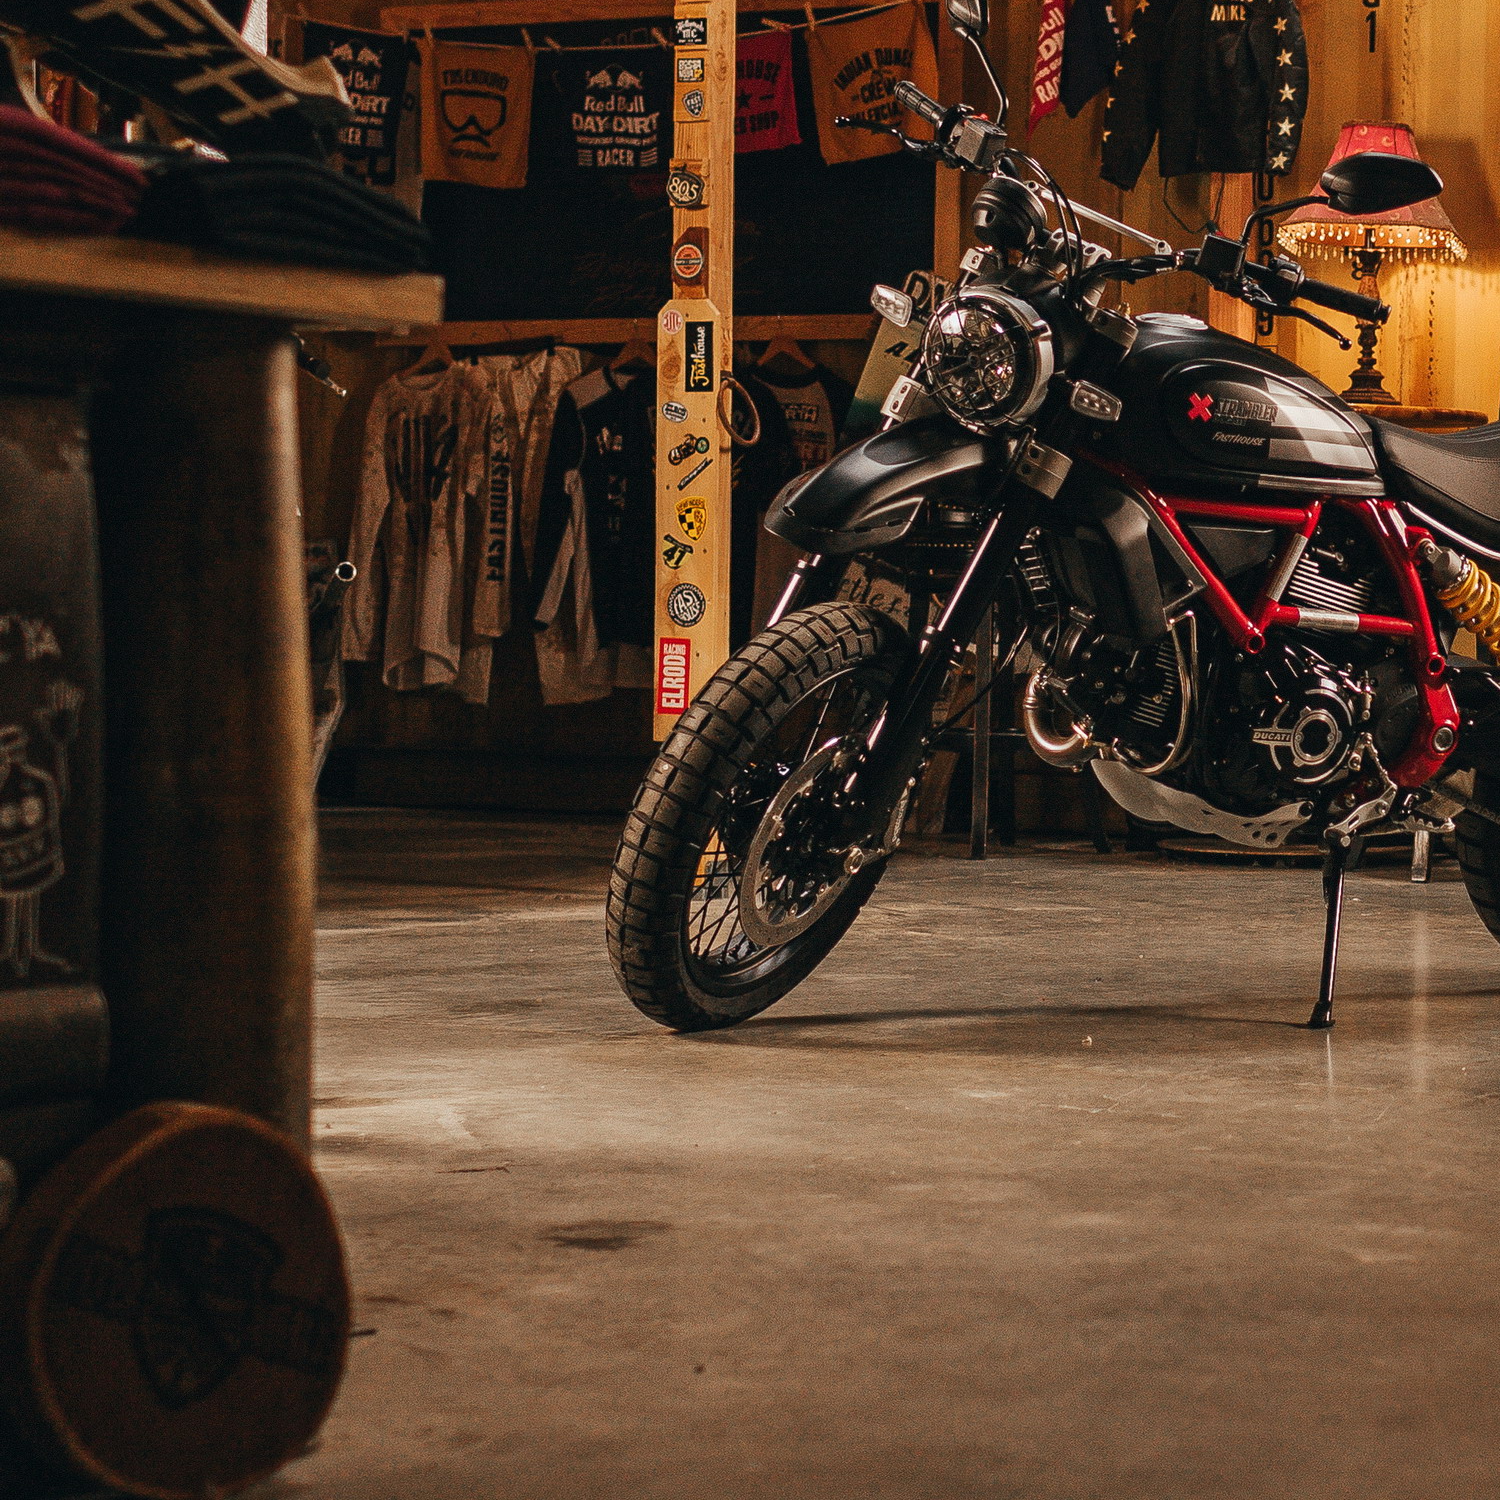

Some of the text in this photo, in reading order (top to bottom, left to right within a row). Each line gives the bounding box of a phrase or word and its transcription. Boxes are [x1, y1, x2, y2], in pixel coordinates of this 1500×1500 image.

[1210, 3, 1248, 22] MIKE
[571, 110, 661, 135] DAY DIRT
[595, 147, 636, 167] RACER
[668, 175, 700, 198] 805
[1212, 431, 1267, 447] FASTHOUSE
[661, 653, 687, 709] ELROD
[1252, 731, 1291, 741] DUCATI
